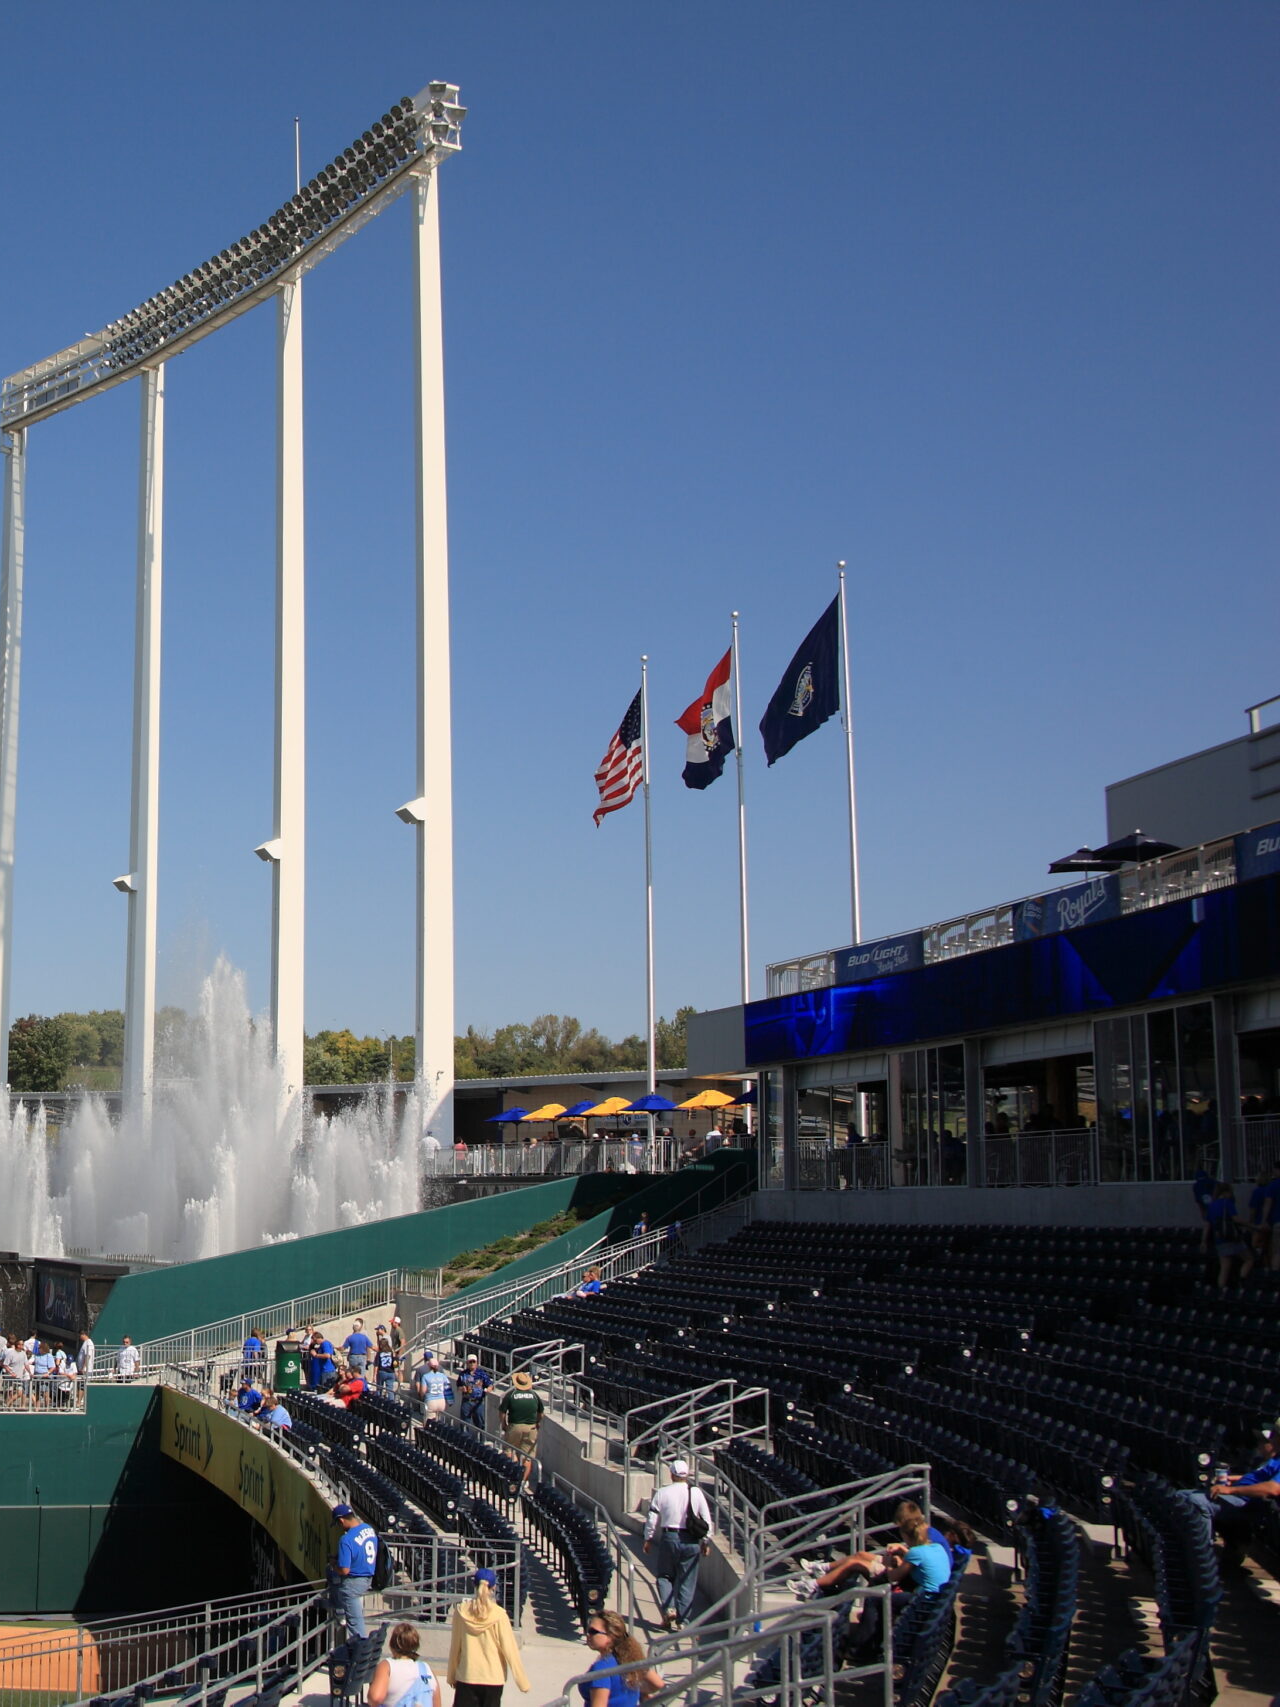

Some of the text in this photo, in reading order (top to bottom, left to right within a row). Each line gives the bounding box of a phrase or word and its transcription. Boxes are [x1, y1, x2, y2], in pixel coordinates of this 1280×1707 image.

[1057, 879, 1107, 931] Royals
[847, 945, 905, 967] BUD LIGHT
[381, 1357, 392, 1367] 23
[431, 1383, 444, 1394] 23
[174, 1412, 201, 1460] Sprint
[238, 1450, 264, 1510] Sprint
[298, 1502, 321, 1577] Sprint
[365, 1540, 376, 1565] 9
